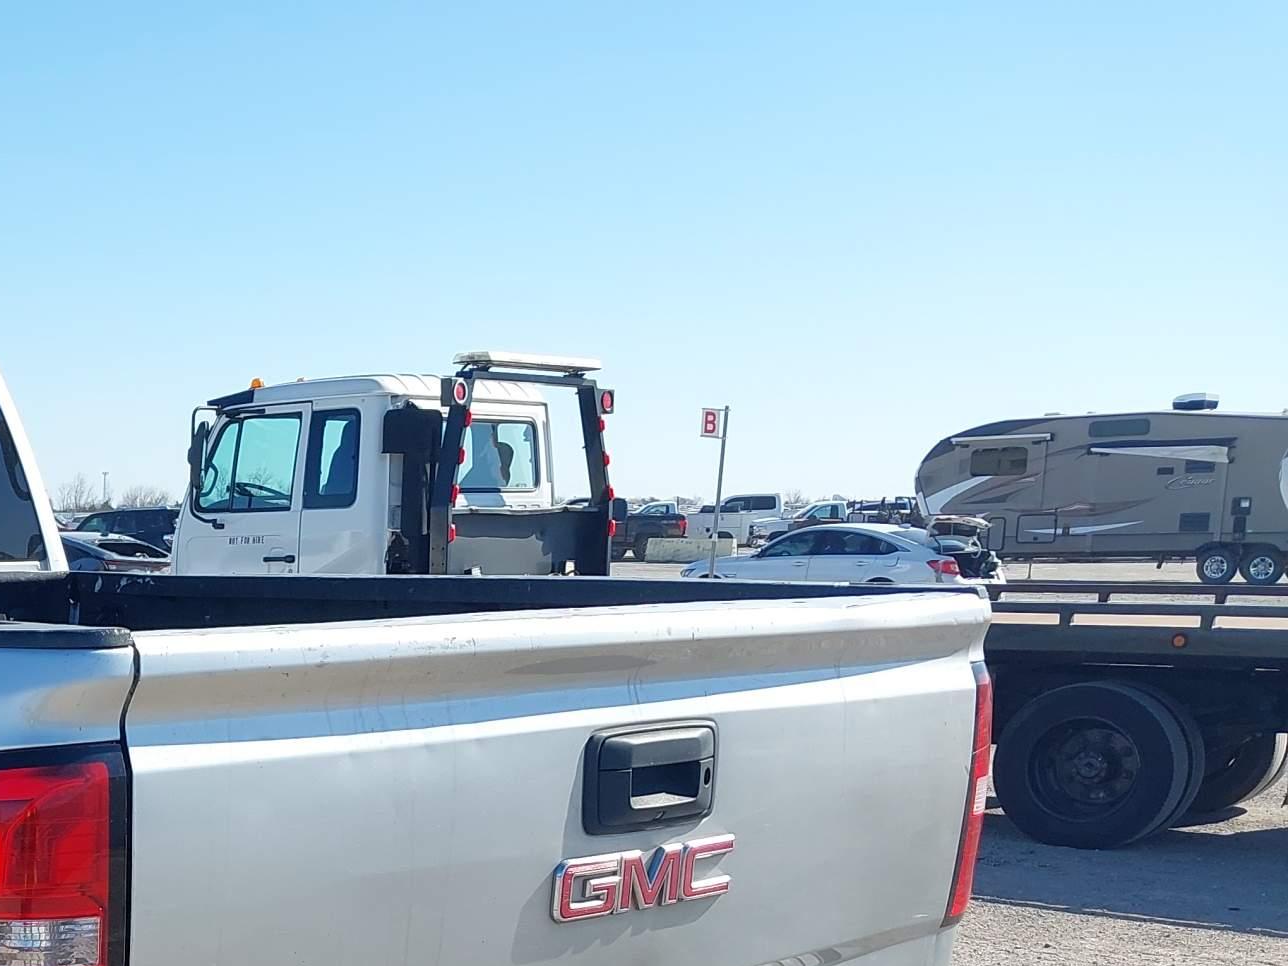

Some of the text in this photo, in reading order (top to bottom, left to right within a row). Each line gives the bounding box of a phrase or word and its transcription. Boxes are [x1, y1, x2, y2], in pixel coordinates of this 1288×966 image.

[704, 411, 716, 433] B
[228, 536, 238, 545] NOT
[240, 536, 250, 545] FOR
[550, 833, 736, 924] GMC
